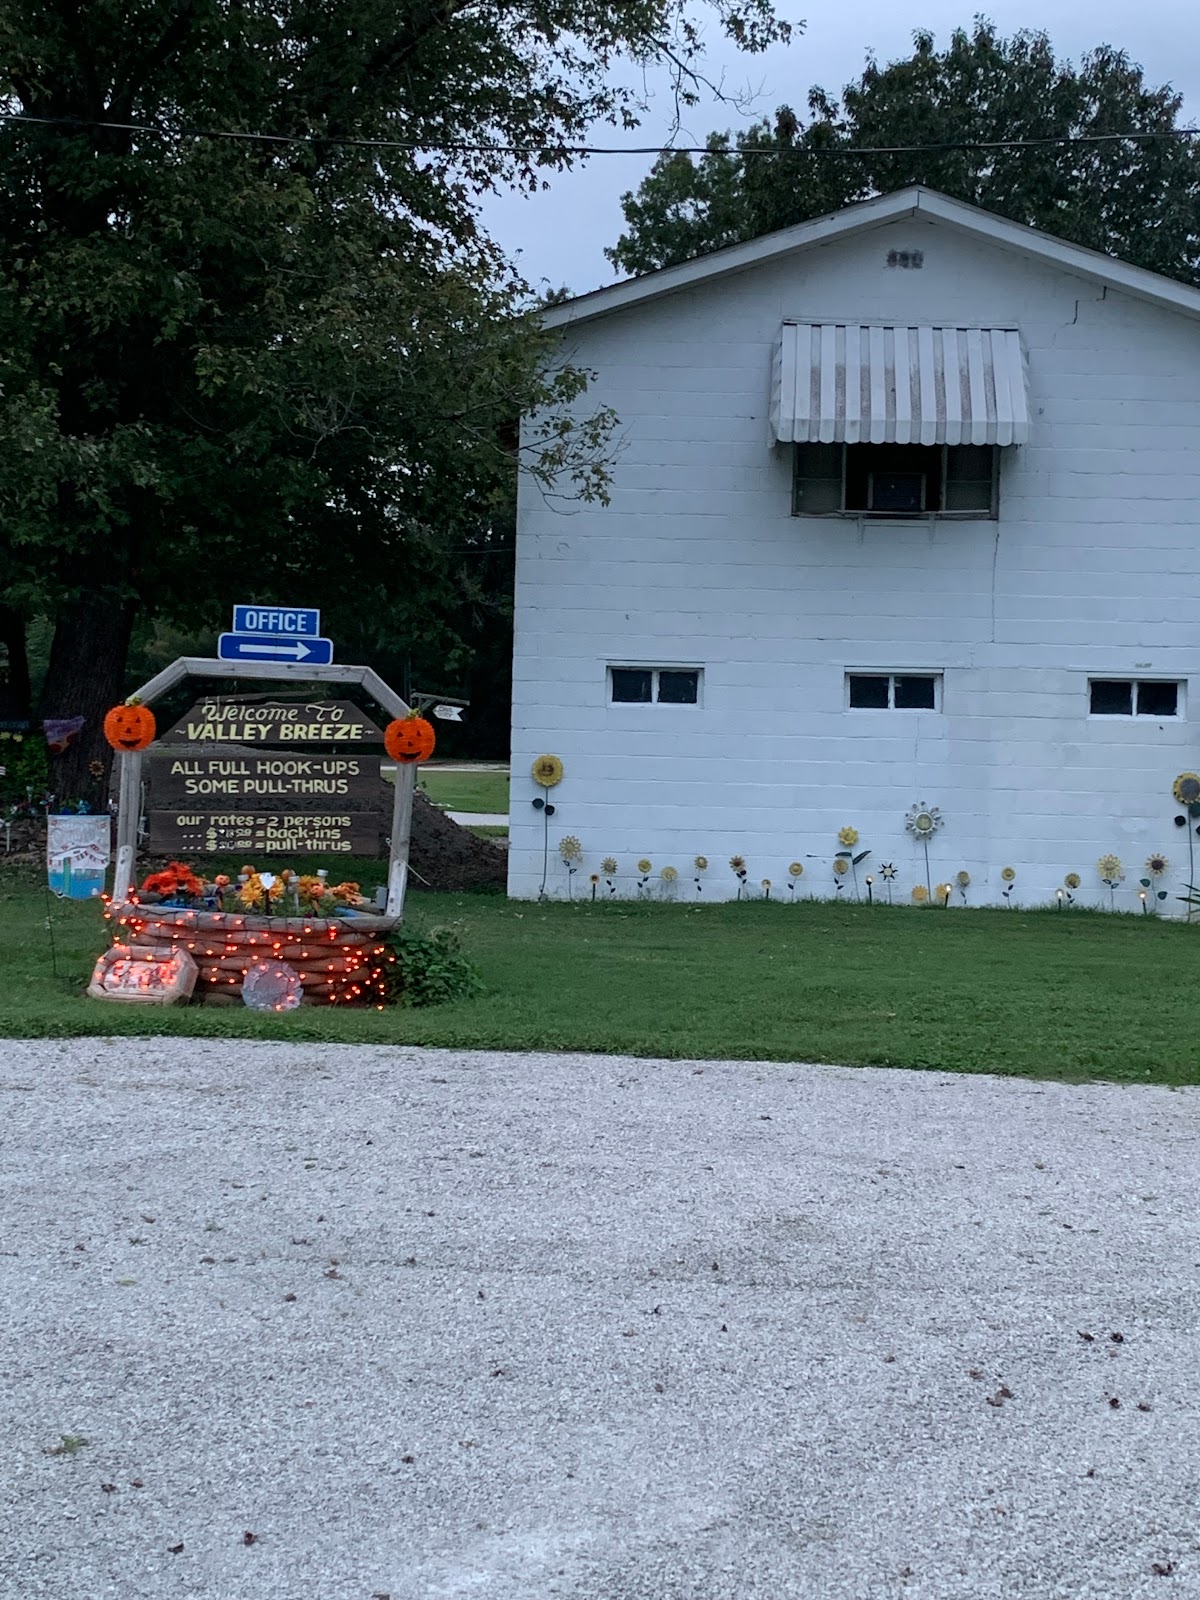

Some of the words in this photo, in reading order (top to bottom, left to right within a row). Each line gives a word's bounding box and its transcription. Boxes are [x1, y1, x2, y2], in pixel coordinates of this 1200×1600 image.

[245, 610, 307, 632] OFFICE
[201, 704, 298, 721] Welcome
[307, 704, 344, 721] To
[187, 723, 273, 740] VALLEY
[279, 723, 364, 740] BREEZE
[170, 761, 204, 775] ALL
[208, 761, 250, 775] FULL
[256, 761, 360, 776] HOOK-UPS
[185, 779, 239, 794] SOME
[243, 779, 348, 794] PULL-THRUS
[176, 815, 204, 826] our
[284, 815, 352, 828] persons
